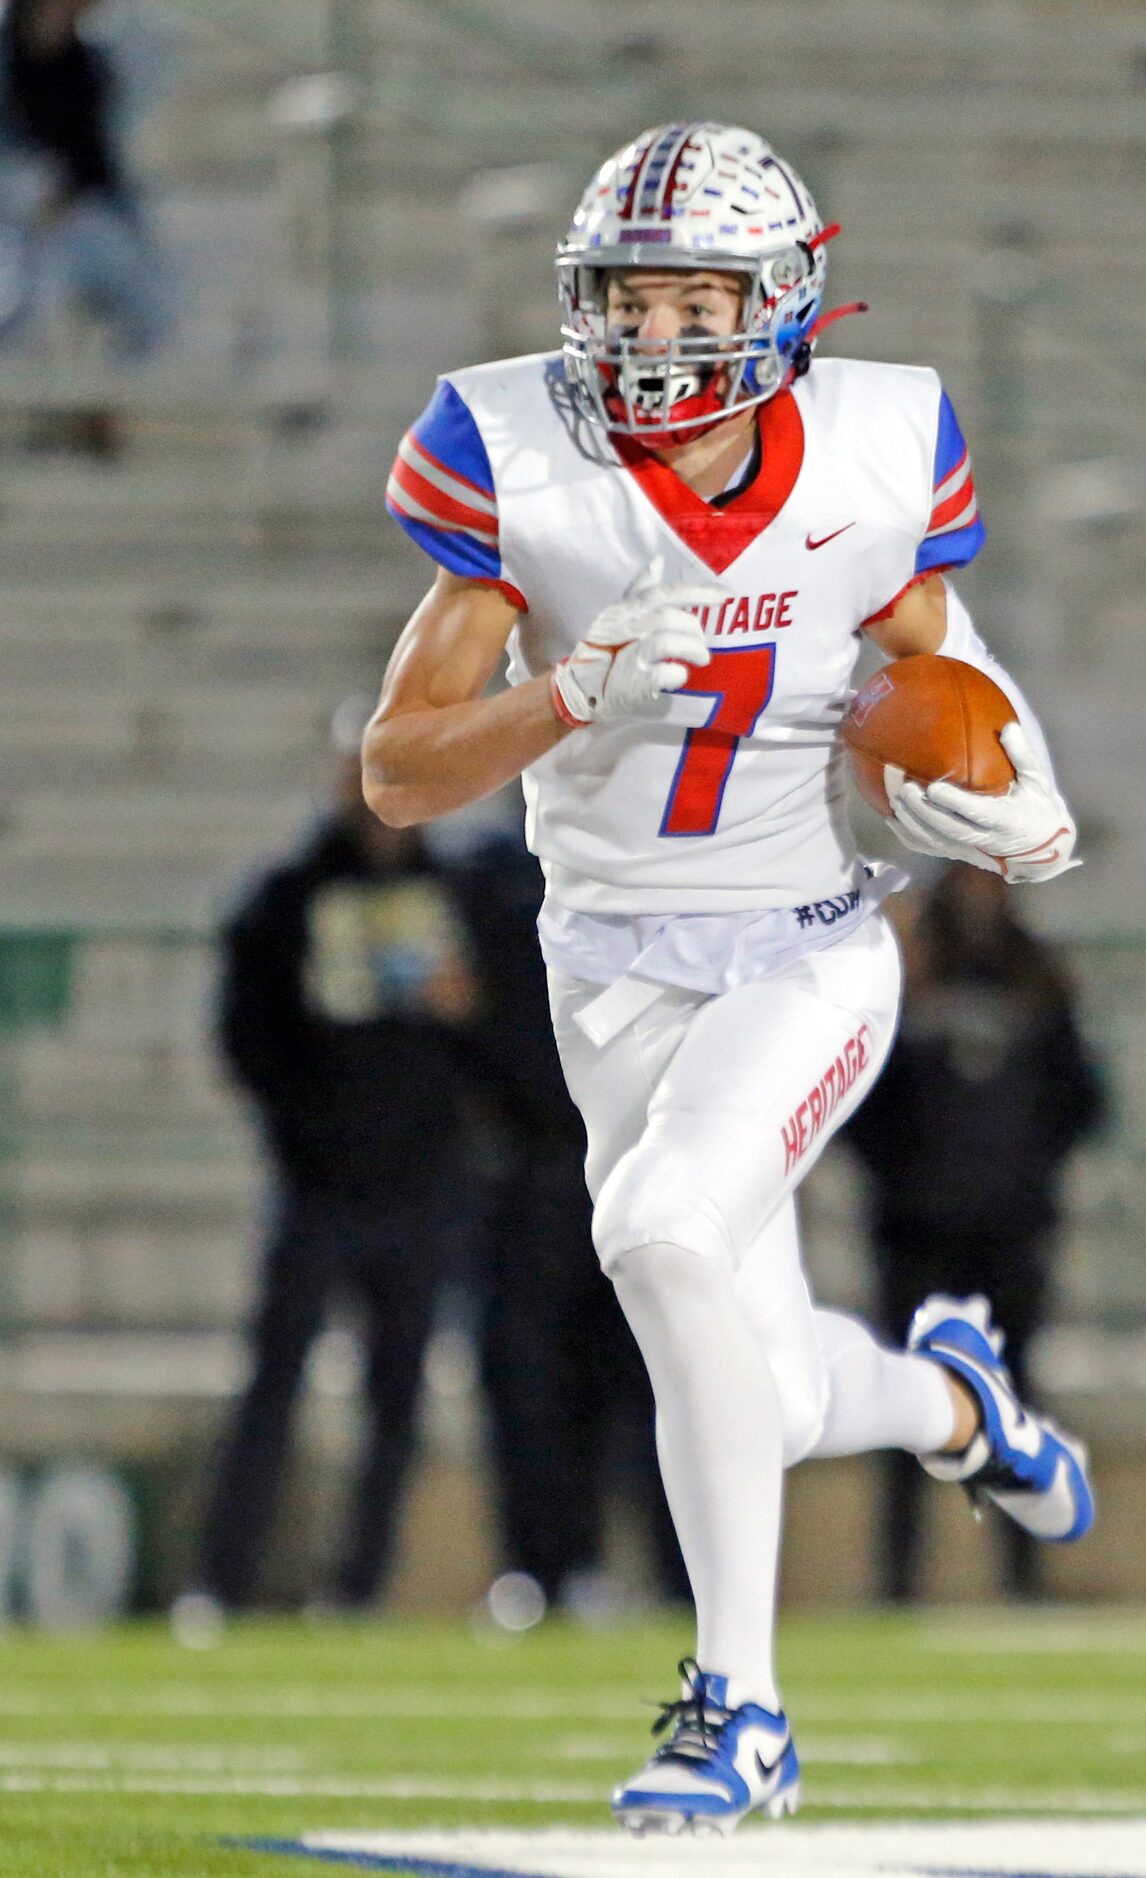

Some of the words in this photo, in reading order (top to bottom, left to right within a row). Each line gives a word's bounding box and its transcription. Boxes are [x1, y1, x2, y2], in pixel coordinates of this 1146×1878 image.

[680, 590, 799, 635] ITAGE
[659, 642, 776, 837] 7
[781, 1024, 869, 1177] HERITAGE
